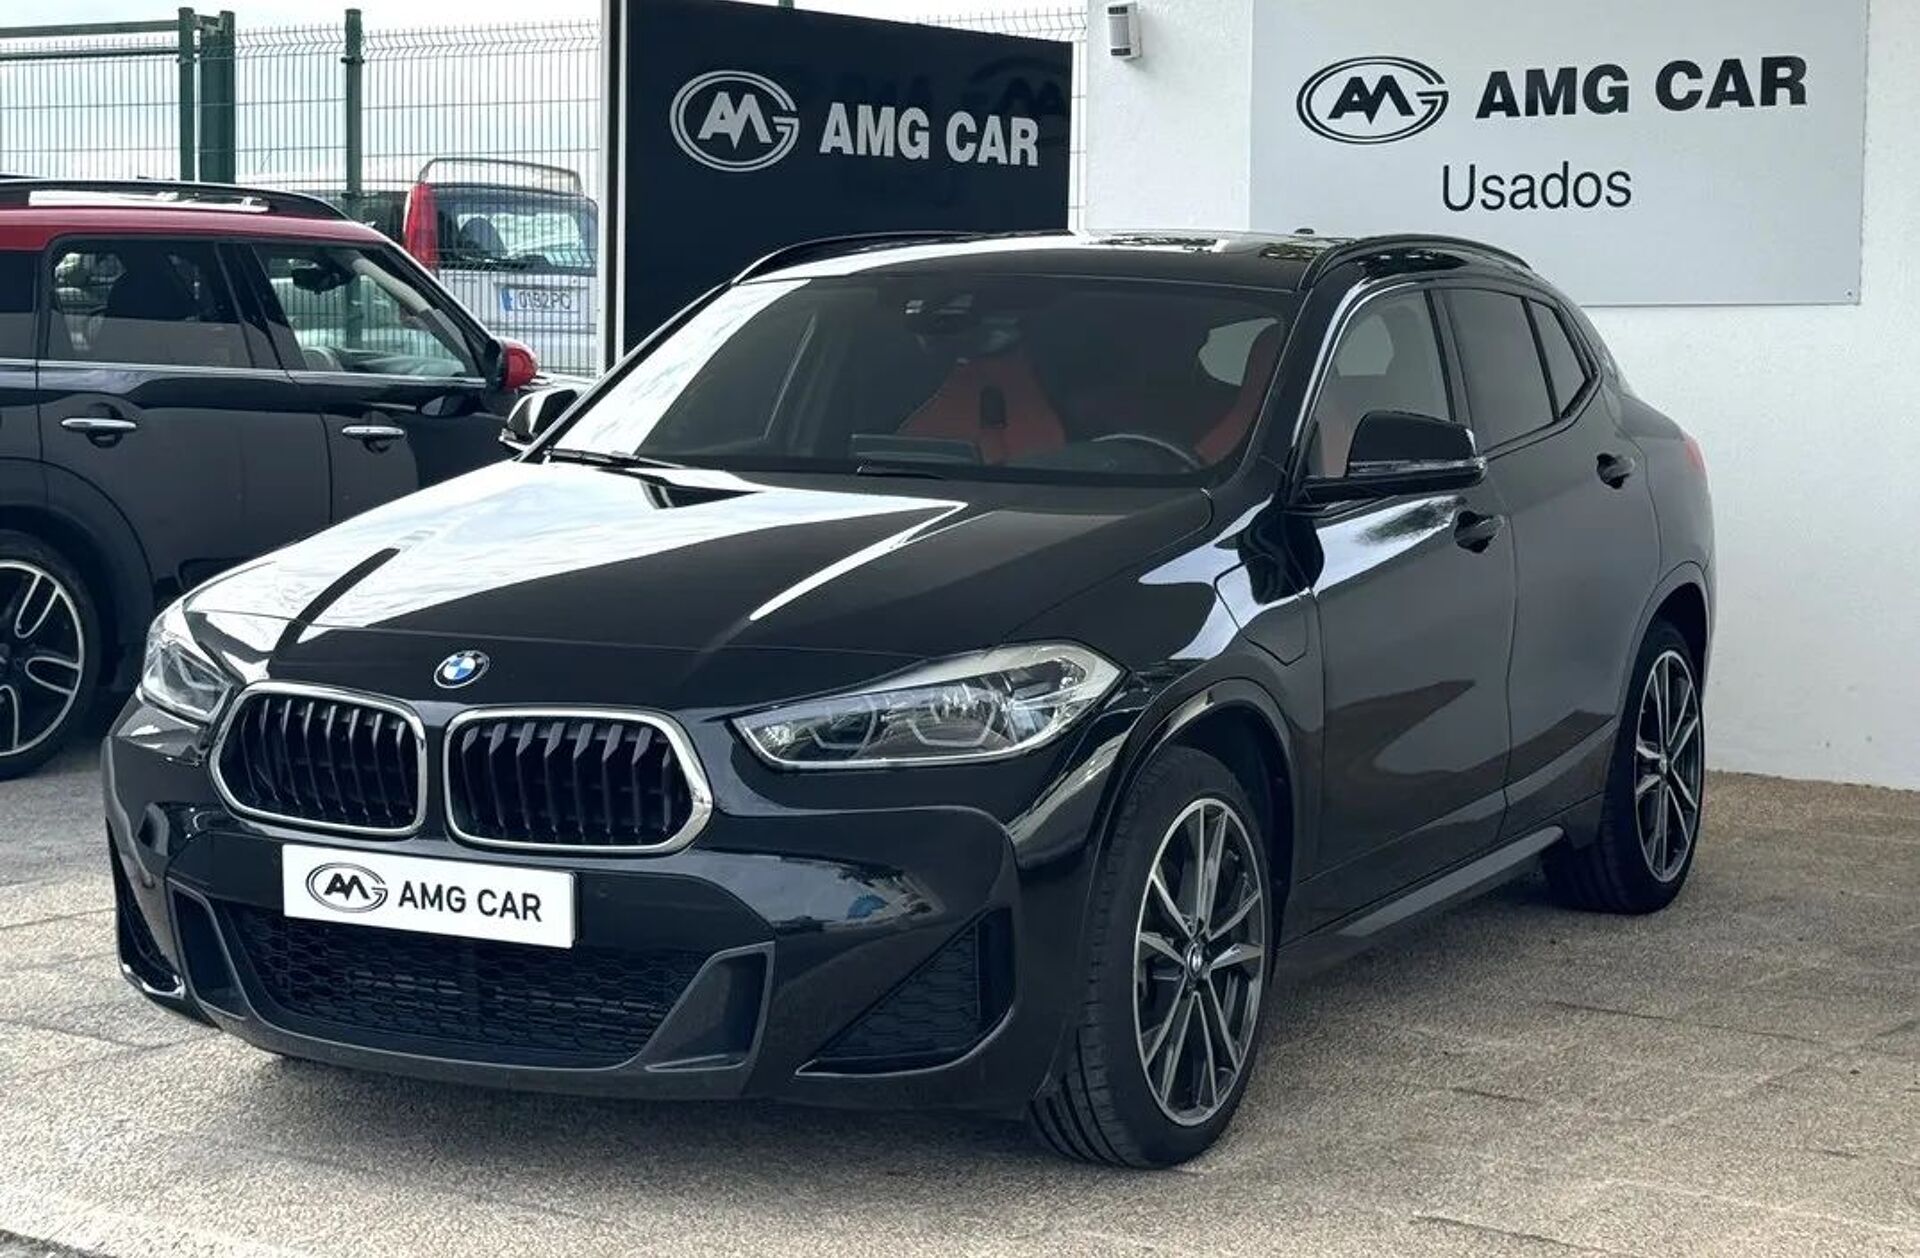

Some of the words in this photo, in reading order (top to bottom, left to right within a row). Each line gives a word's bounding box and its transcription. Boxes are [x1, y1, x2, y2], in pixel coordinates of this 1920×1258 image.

[1476, 64, 1629, 118] AMG
[1656, 56, 1806, 111] CAR
[820, 103, 929, 159] AMG
[946, 111, 1038, 166] CAR
[1443, 161, 1631, 211] Usados
[399, 881, 466, 913] AMG
[478, 890, 541, 922] CAR
